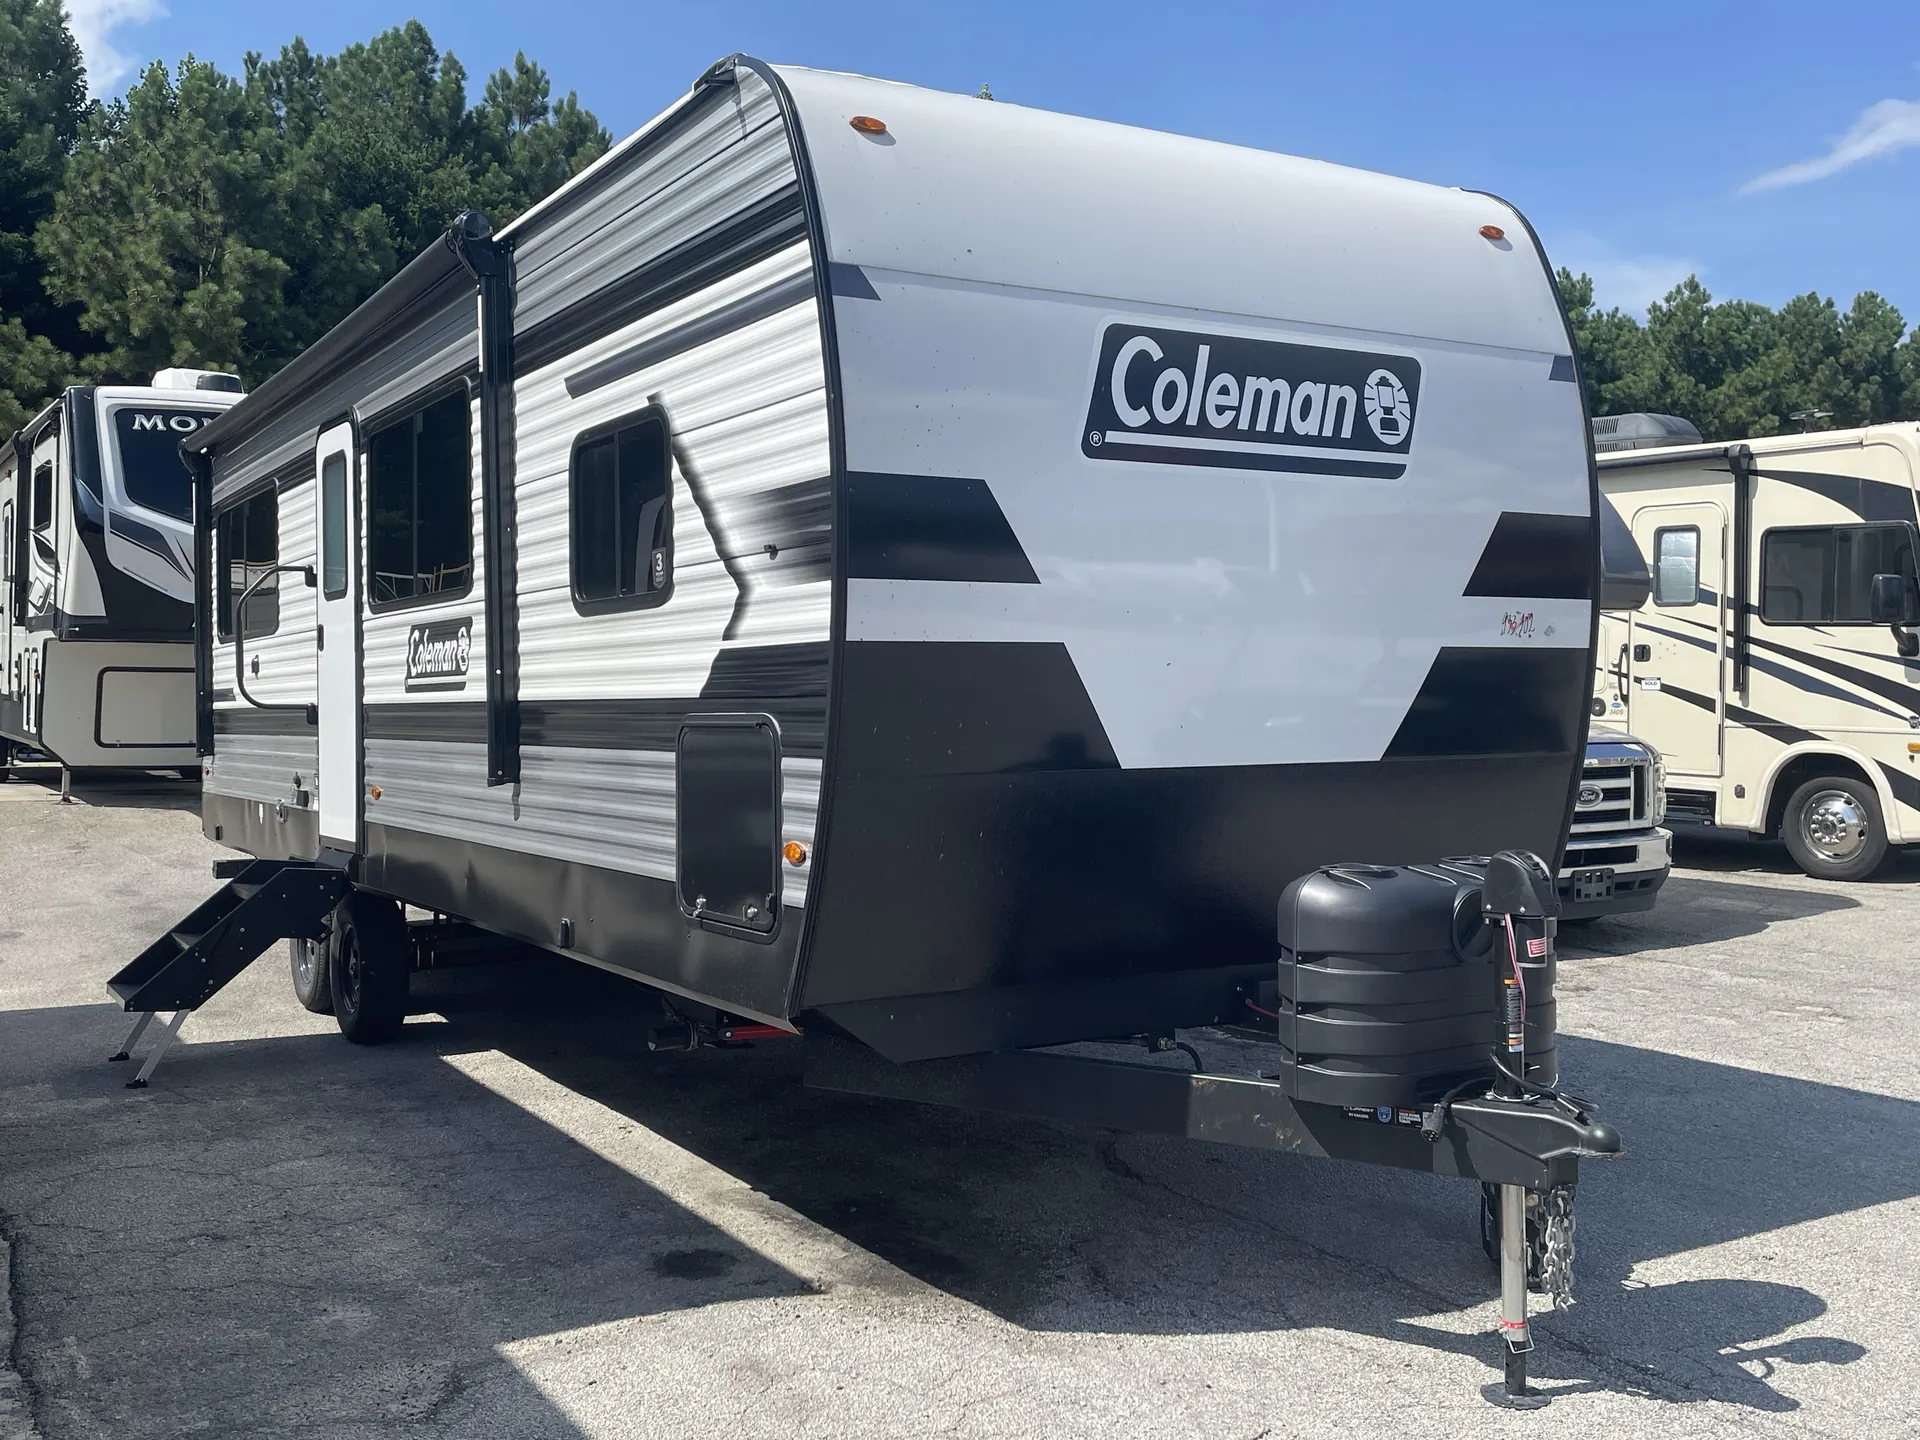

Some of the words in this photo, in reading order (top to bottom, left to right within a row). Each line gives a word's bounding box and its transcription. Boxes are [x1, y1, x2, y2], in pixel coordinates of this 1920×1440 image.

[1111, 335, 1357, 439] Coleman
[655, 552, 663, 571] 3
[409, 628, 458, 677] Coleman
[1580, 790, 1597, 801] Ford
